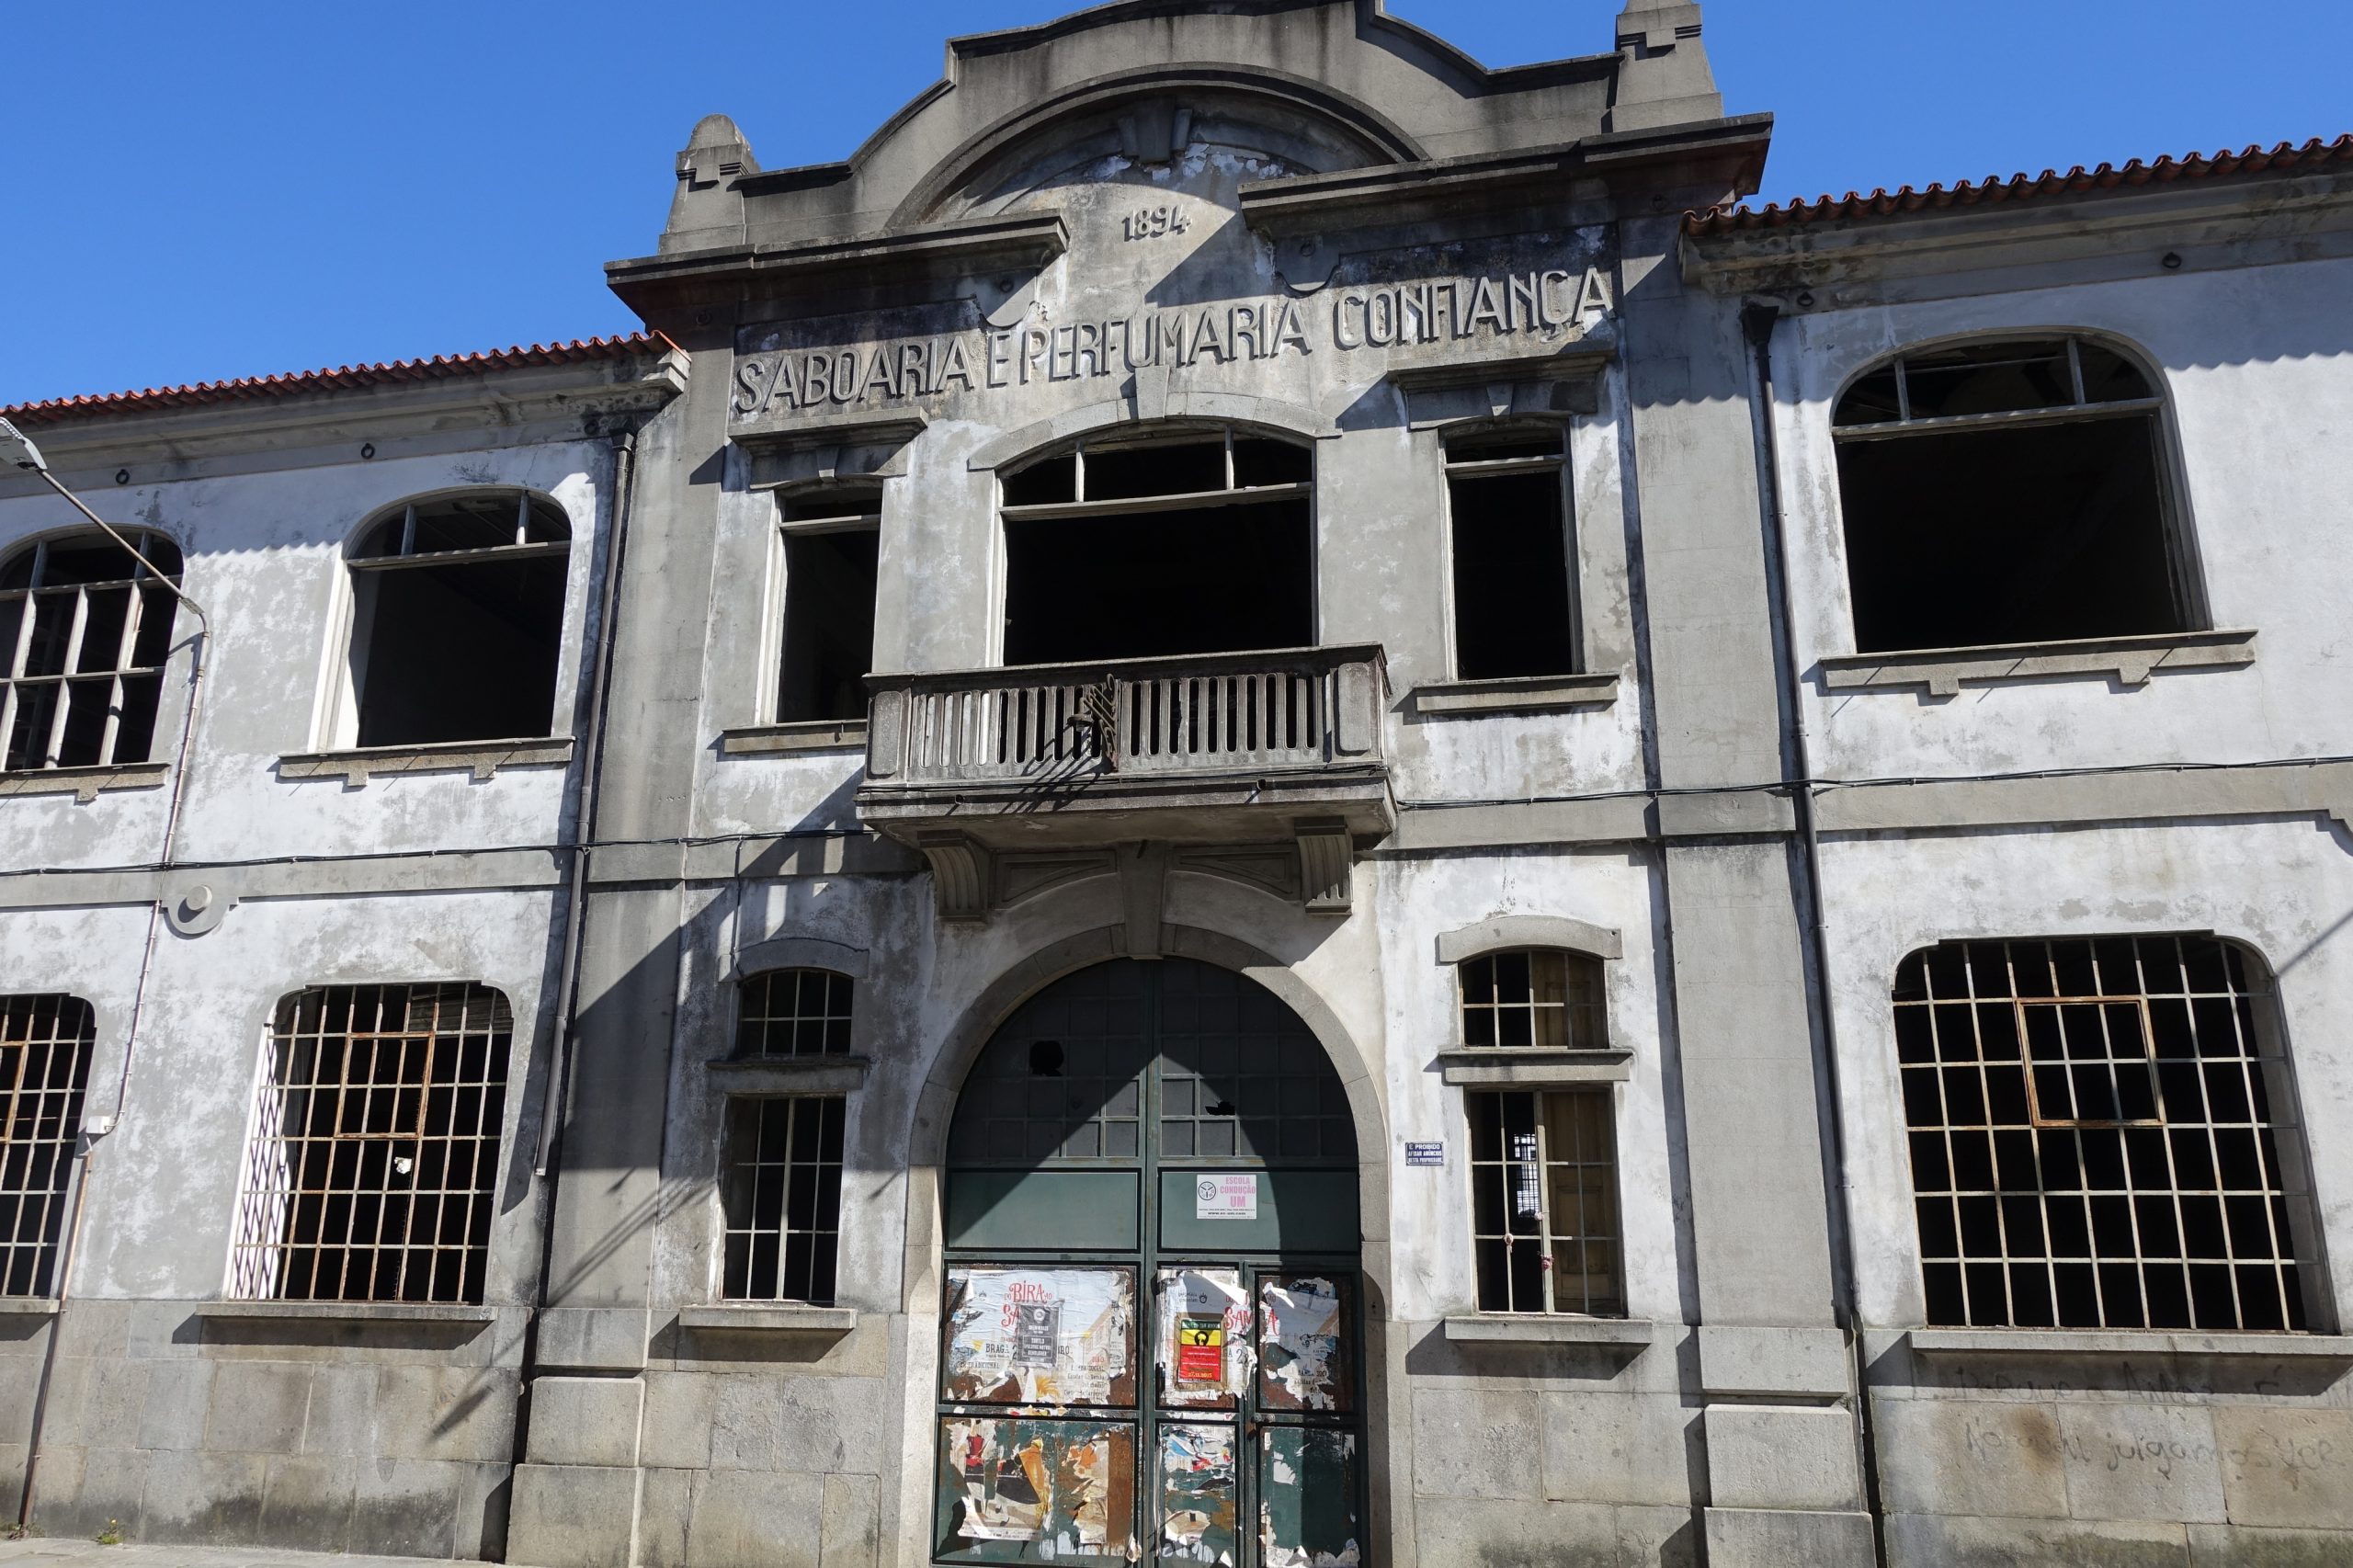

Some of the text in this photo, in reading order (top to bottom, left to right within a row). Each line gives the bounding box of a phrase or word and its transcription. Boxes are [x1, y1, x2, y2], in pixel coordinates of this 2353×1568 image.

[1121, 204, 1192, 242] 1894
[736, 264, 1618, 413] SABOARIA E PERFUMARIA CONFIANÇA
[1230, 1196, 1246, 1207] UM
